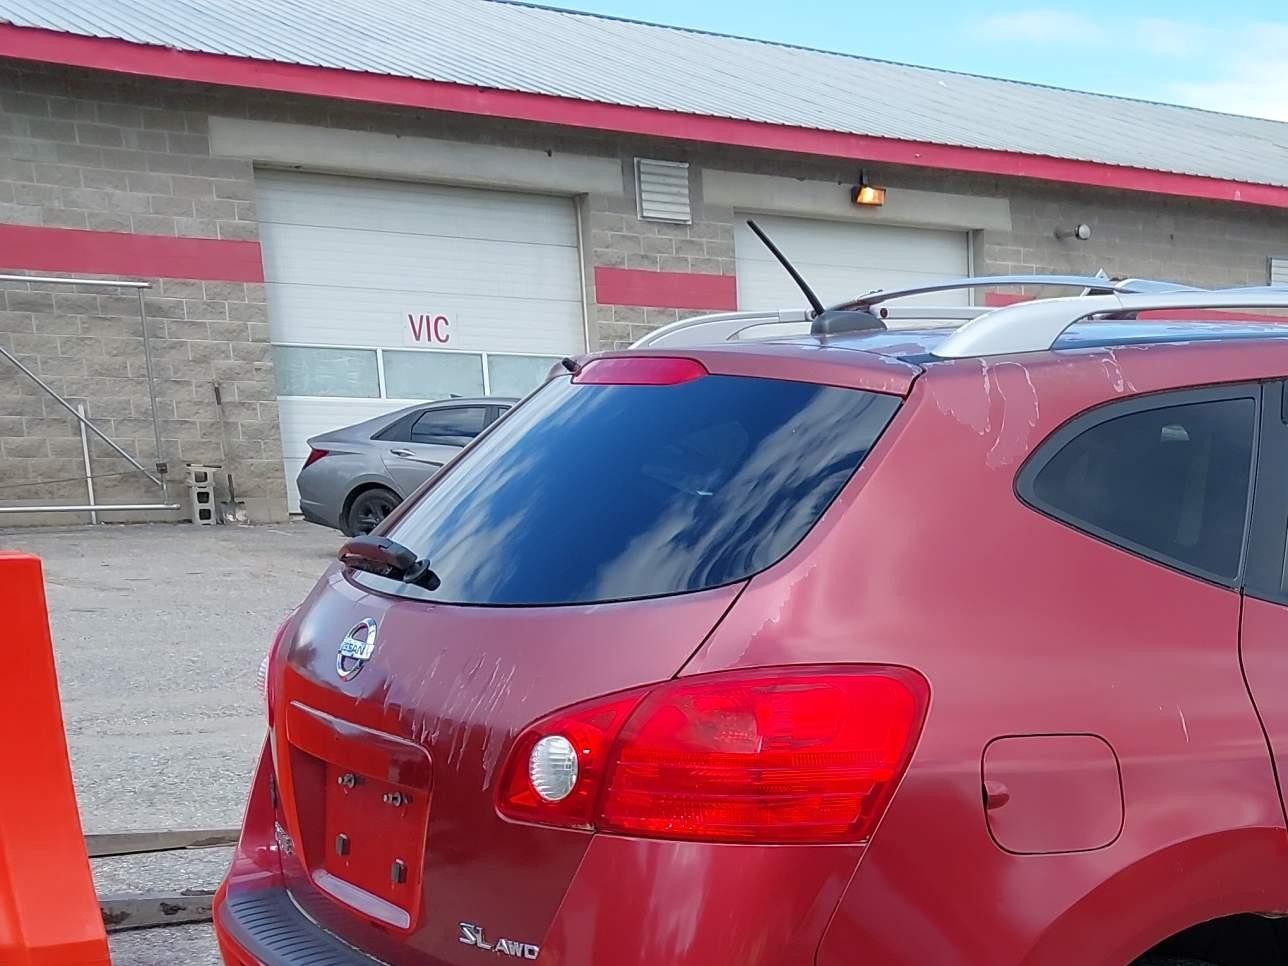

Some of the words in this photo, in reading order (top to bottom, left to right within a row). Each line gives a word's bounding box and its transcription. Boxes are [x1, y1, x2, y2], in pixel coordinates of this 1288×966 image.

[408, 314, 450, 343] VIC
[459, 922, 492, 949] SL
[493, 938, 539, 960] AWD
